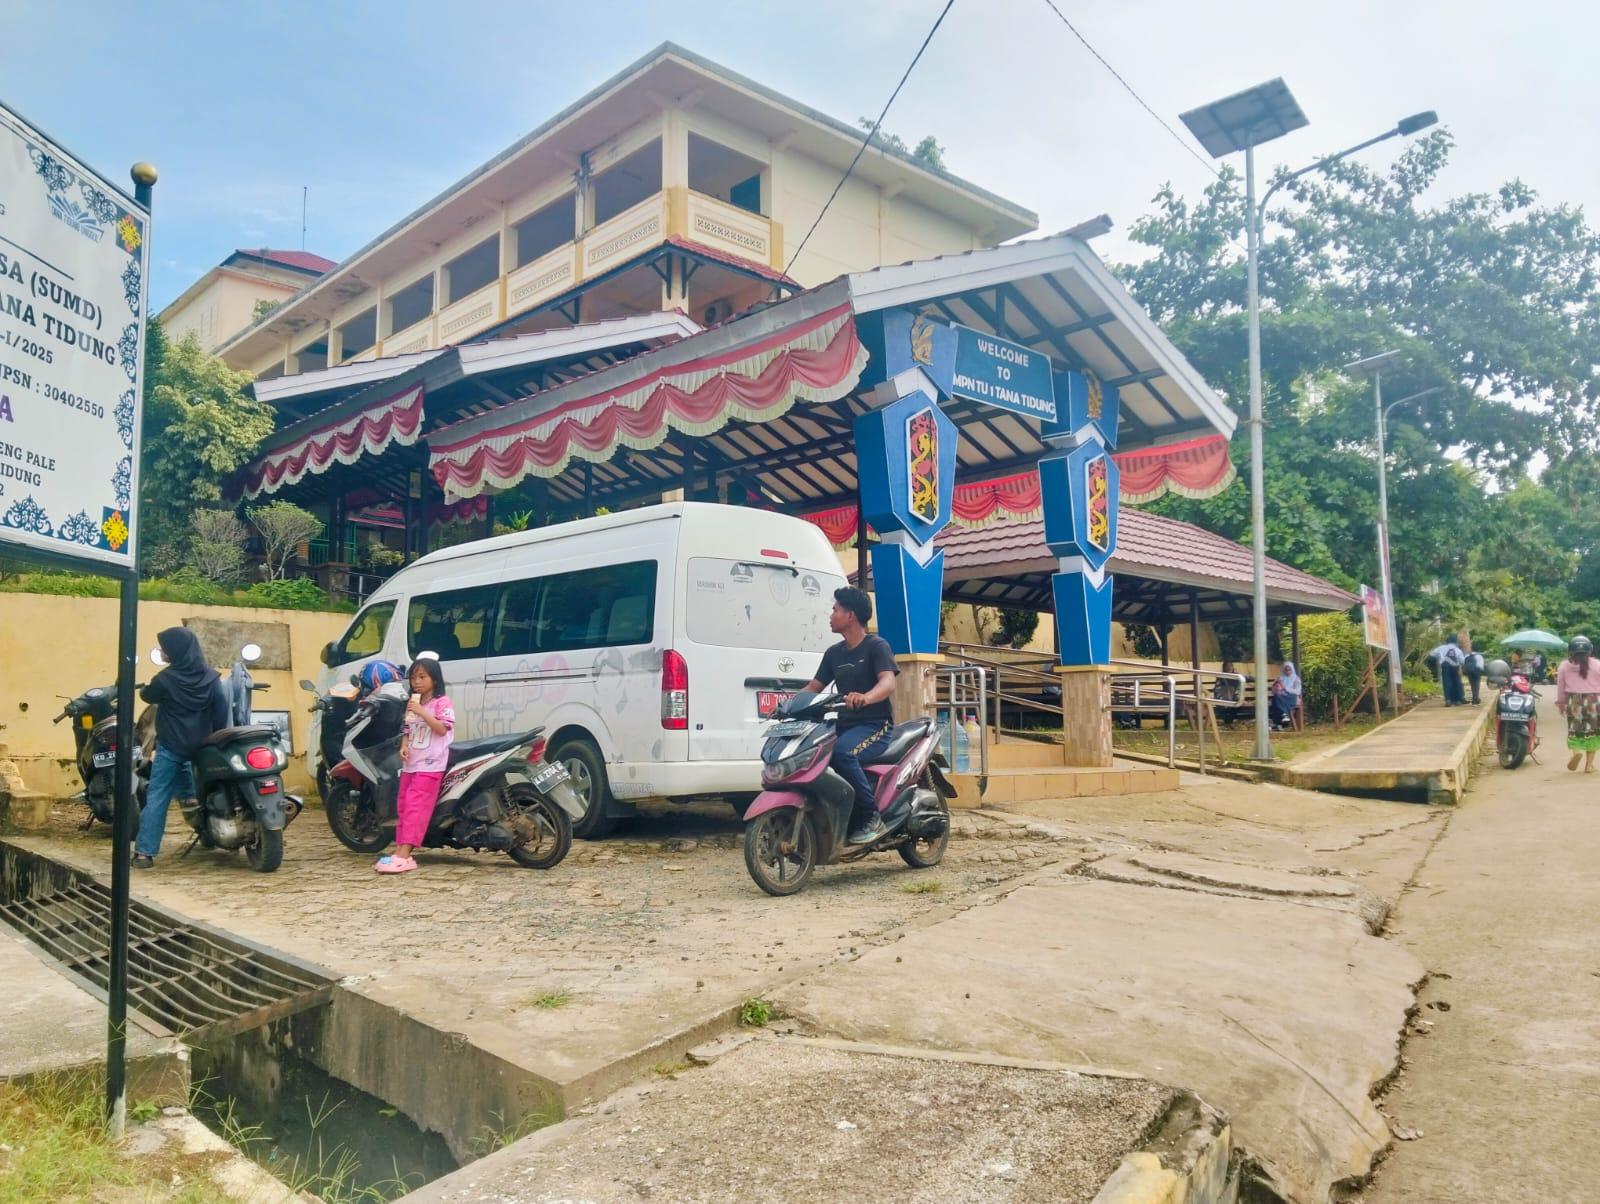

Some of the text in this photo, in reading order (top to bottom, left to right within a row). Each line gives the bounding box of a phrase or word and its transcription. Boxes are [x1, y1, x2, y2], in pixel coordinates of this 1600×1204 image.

[31, 271, 102, 330] (SUMD)
[43, 312, 116, 366] TIDUNG
[977, 339, 1029, 367] WELCOME
[997, 366, 1011, 381] TO
[0, 363, 32, 390] PSN
[44, 383, 104, 419] 30402550
[976, 380, 989, 395] TU
[995, 386, 1021, 405] TANA
[1021, 394, 1056, 414] TIDUNG
[26, 450, 56, 472] PALE
